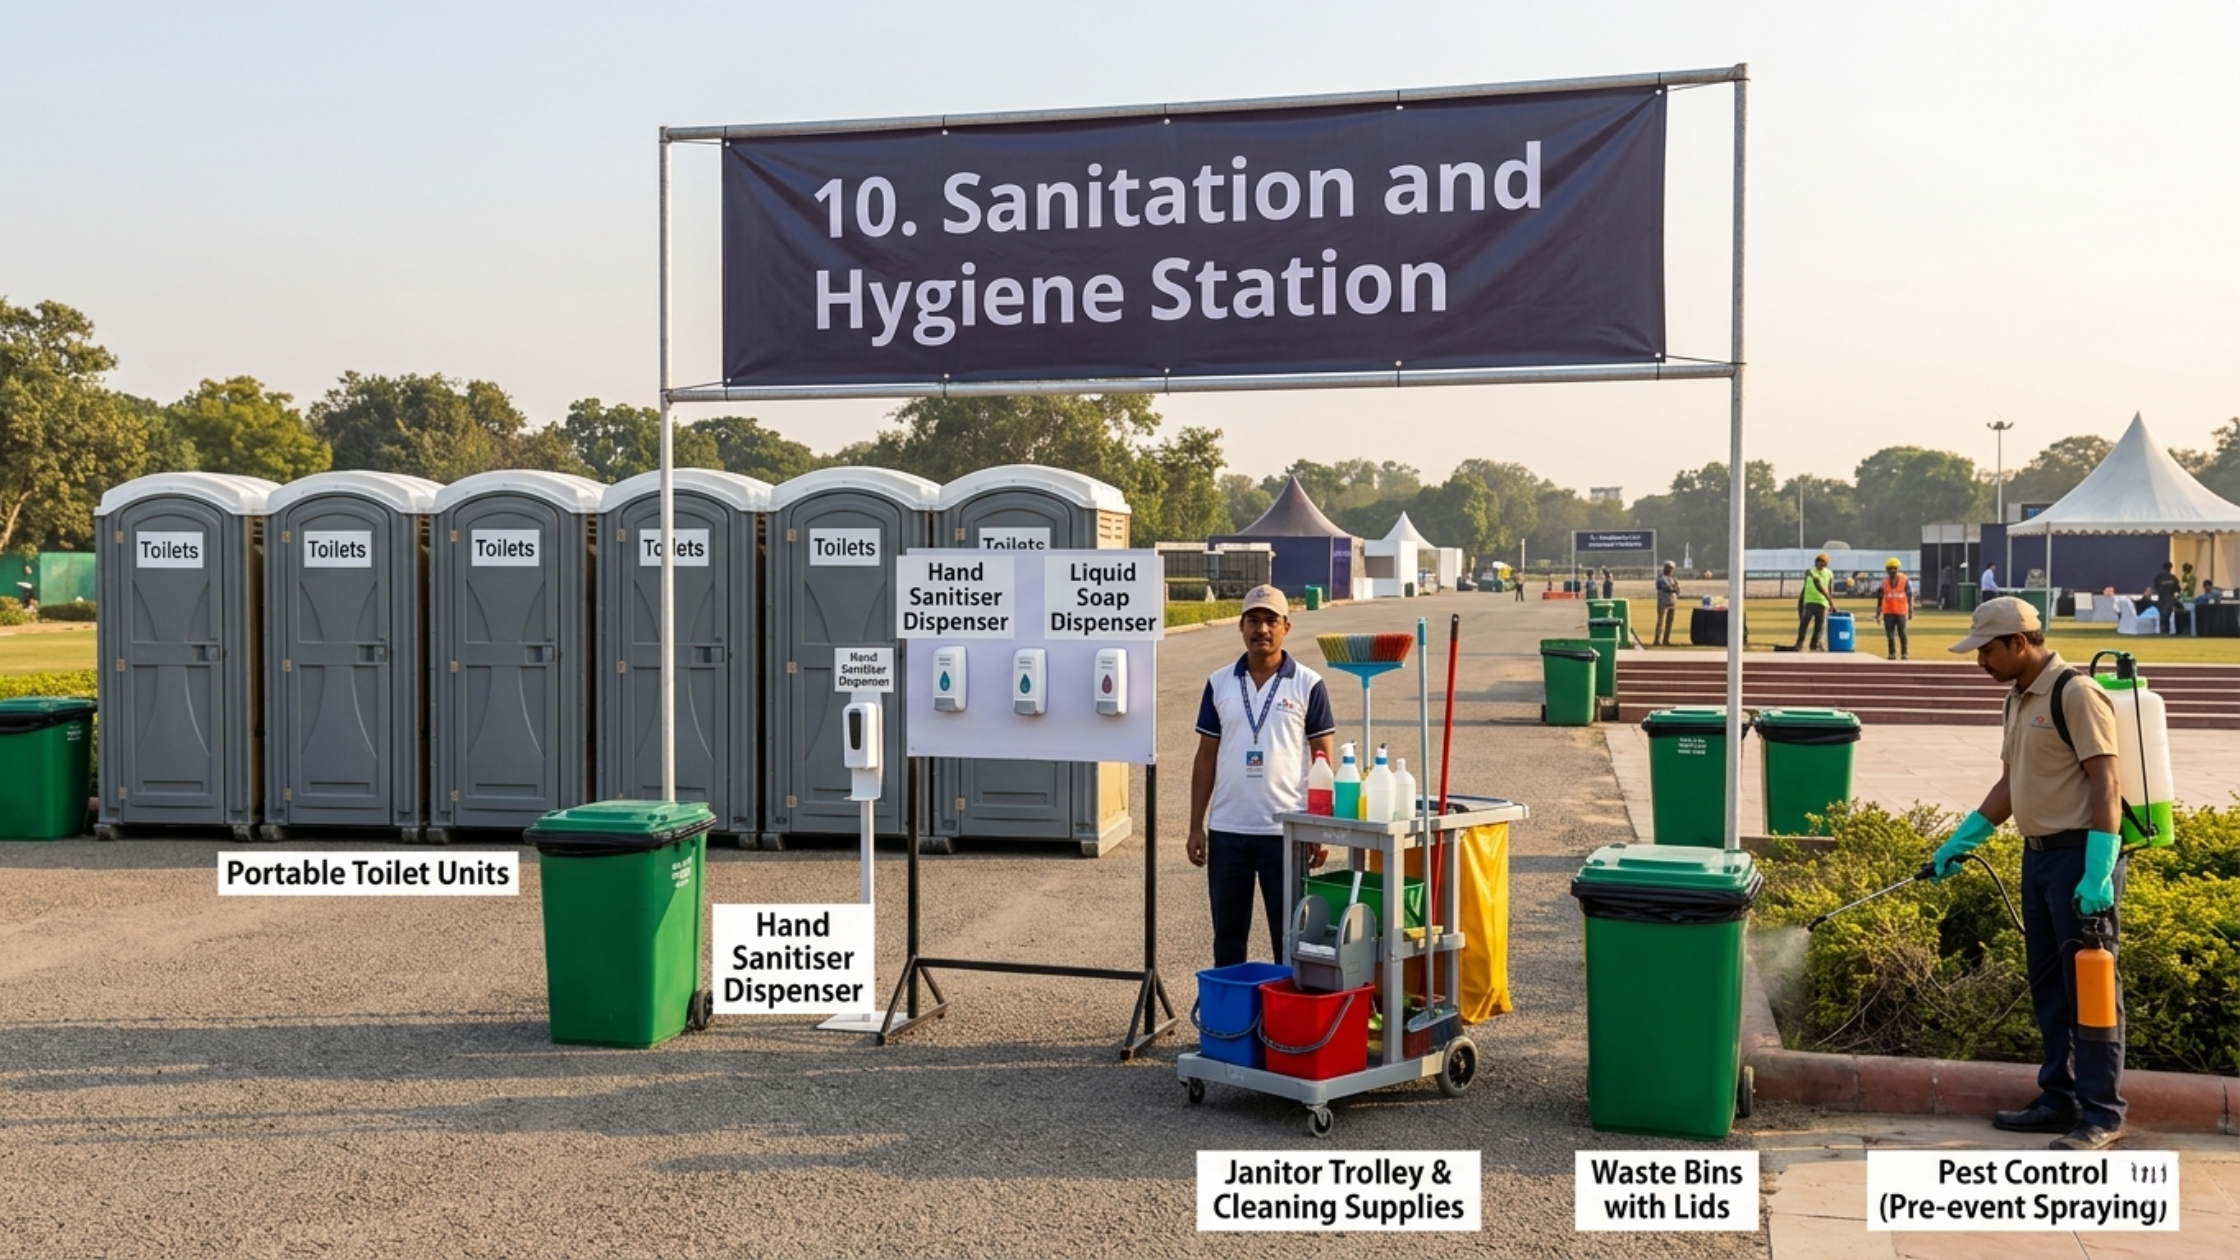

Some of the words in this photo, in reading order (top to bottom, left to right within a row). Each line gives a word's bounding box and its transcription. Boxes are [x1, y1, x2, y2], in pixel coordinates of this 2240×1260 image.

[814, 176, 917, 239] 10.
[943, 155, 1354, 234] Sanitation
[1384, 140, 1542, 216] and
[816, 261, 1125, 347] Hygiene
[1151, 248, 1447, 321] Station
[139, 540, 199, 559] Toilets
[307, 539, 367, 559] Toilets
[475, 538, 535, 557] Toilets
[642, 538, 705, 558] Tolets
[813, 537, 876, 557] Toilets
[928, 561, 984, 582] Hand
[1070, 562, 1136, 587] Liquid
[909, 586, 1003, 607] Sanitiser
[1076, 587, 1130, 611] Soap
[903, 611, 1009, 636] Dispenser
[1050, 611, 1157, 636] Dispenser
